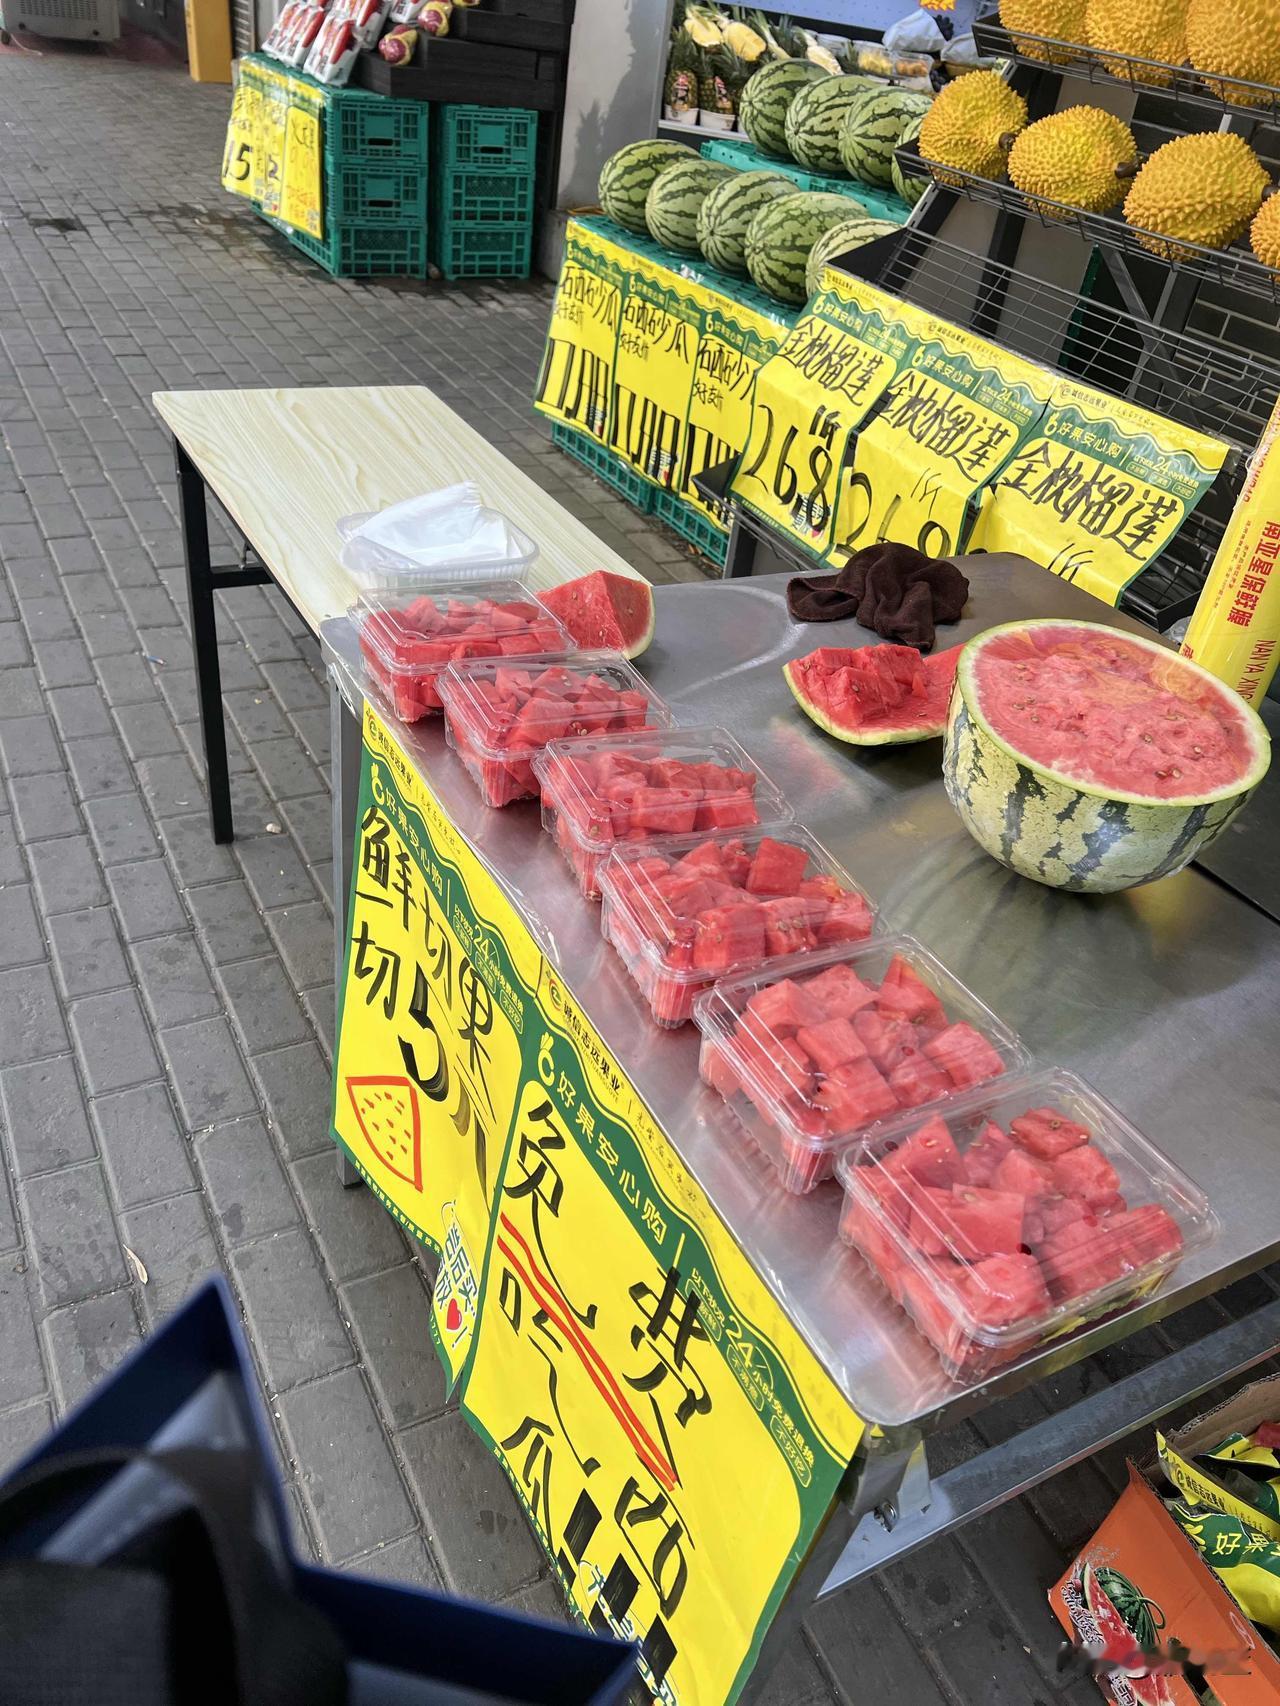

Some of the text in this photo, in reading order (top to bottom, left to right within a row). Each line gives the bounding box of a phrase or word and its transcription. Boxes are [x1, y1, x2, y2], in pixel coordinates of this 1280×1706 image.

[922, 353, 974, 389] 好果安心购
[1056, 419, 1122, 460] 好果安心购
[384, 791, 444, 898] 好果安心购
[560, 999, 621, 1098] 诚信志远果业
[554, 1068, 669, 1247] 好果安心购
[504, 1099, 712, 1490] 免费
